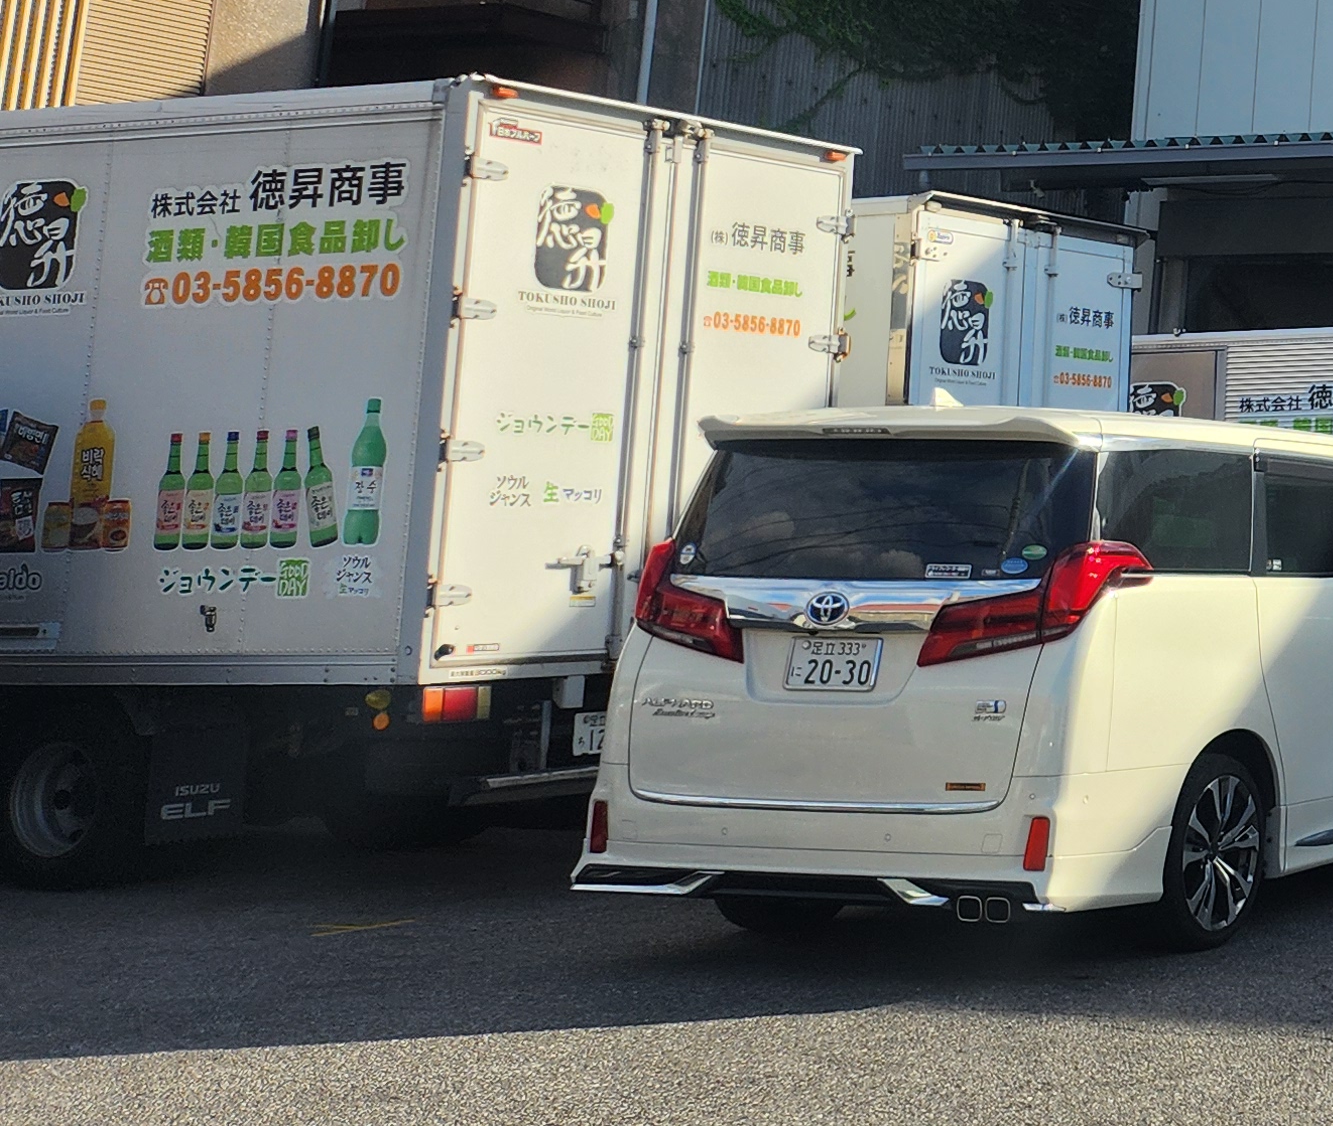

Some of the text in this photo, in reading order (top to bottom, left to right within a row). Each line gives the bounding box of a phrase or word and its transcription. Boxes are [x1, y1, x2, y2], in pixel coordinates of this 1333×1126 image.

[151, 162, 407, 218] 株式会社 徳昇商事
[145, 218, 405, 264] 酒類・韓国食品卸し
[171, 263, 400, 305] 03-5856-8870
[45, 293, 84, 304] SHOJI
[518, 291, 616, 310] TOKUSHO SHOJI
[713, 311, 801, 337] 03-5856-8870
[1239, 396, 1303, 413] 株式会社
[496, 412, 590, 436] ジョウンデー
[497, 475, 529, 490] ソウル
[489, 490, 531, 507] ジャンス
[343, 556, 371, 569] ソウル
[159, 567, 277, 594] ジョウンデー
[279, 577, 307, 596] DAY
[811, 641, 861, 656] 足立 333
[791, 658, 872, 686] に 20-30
[175, 782, 221, 797] ISUZU
[160, 798, 231, 820] ELF
